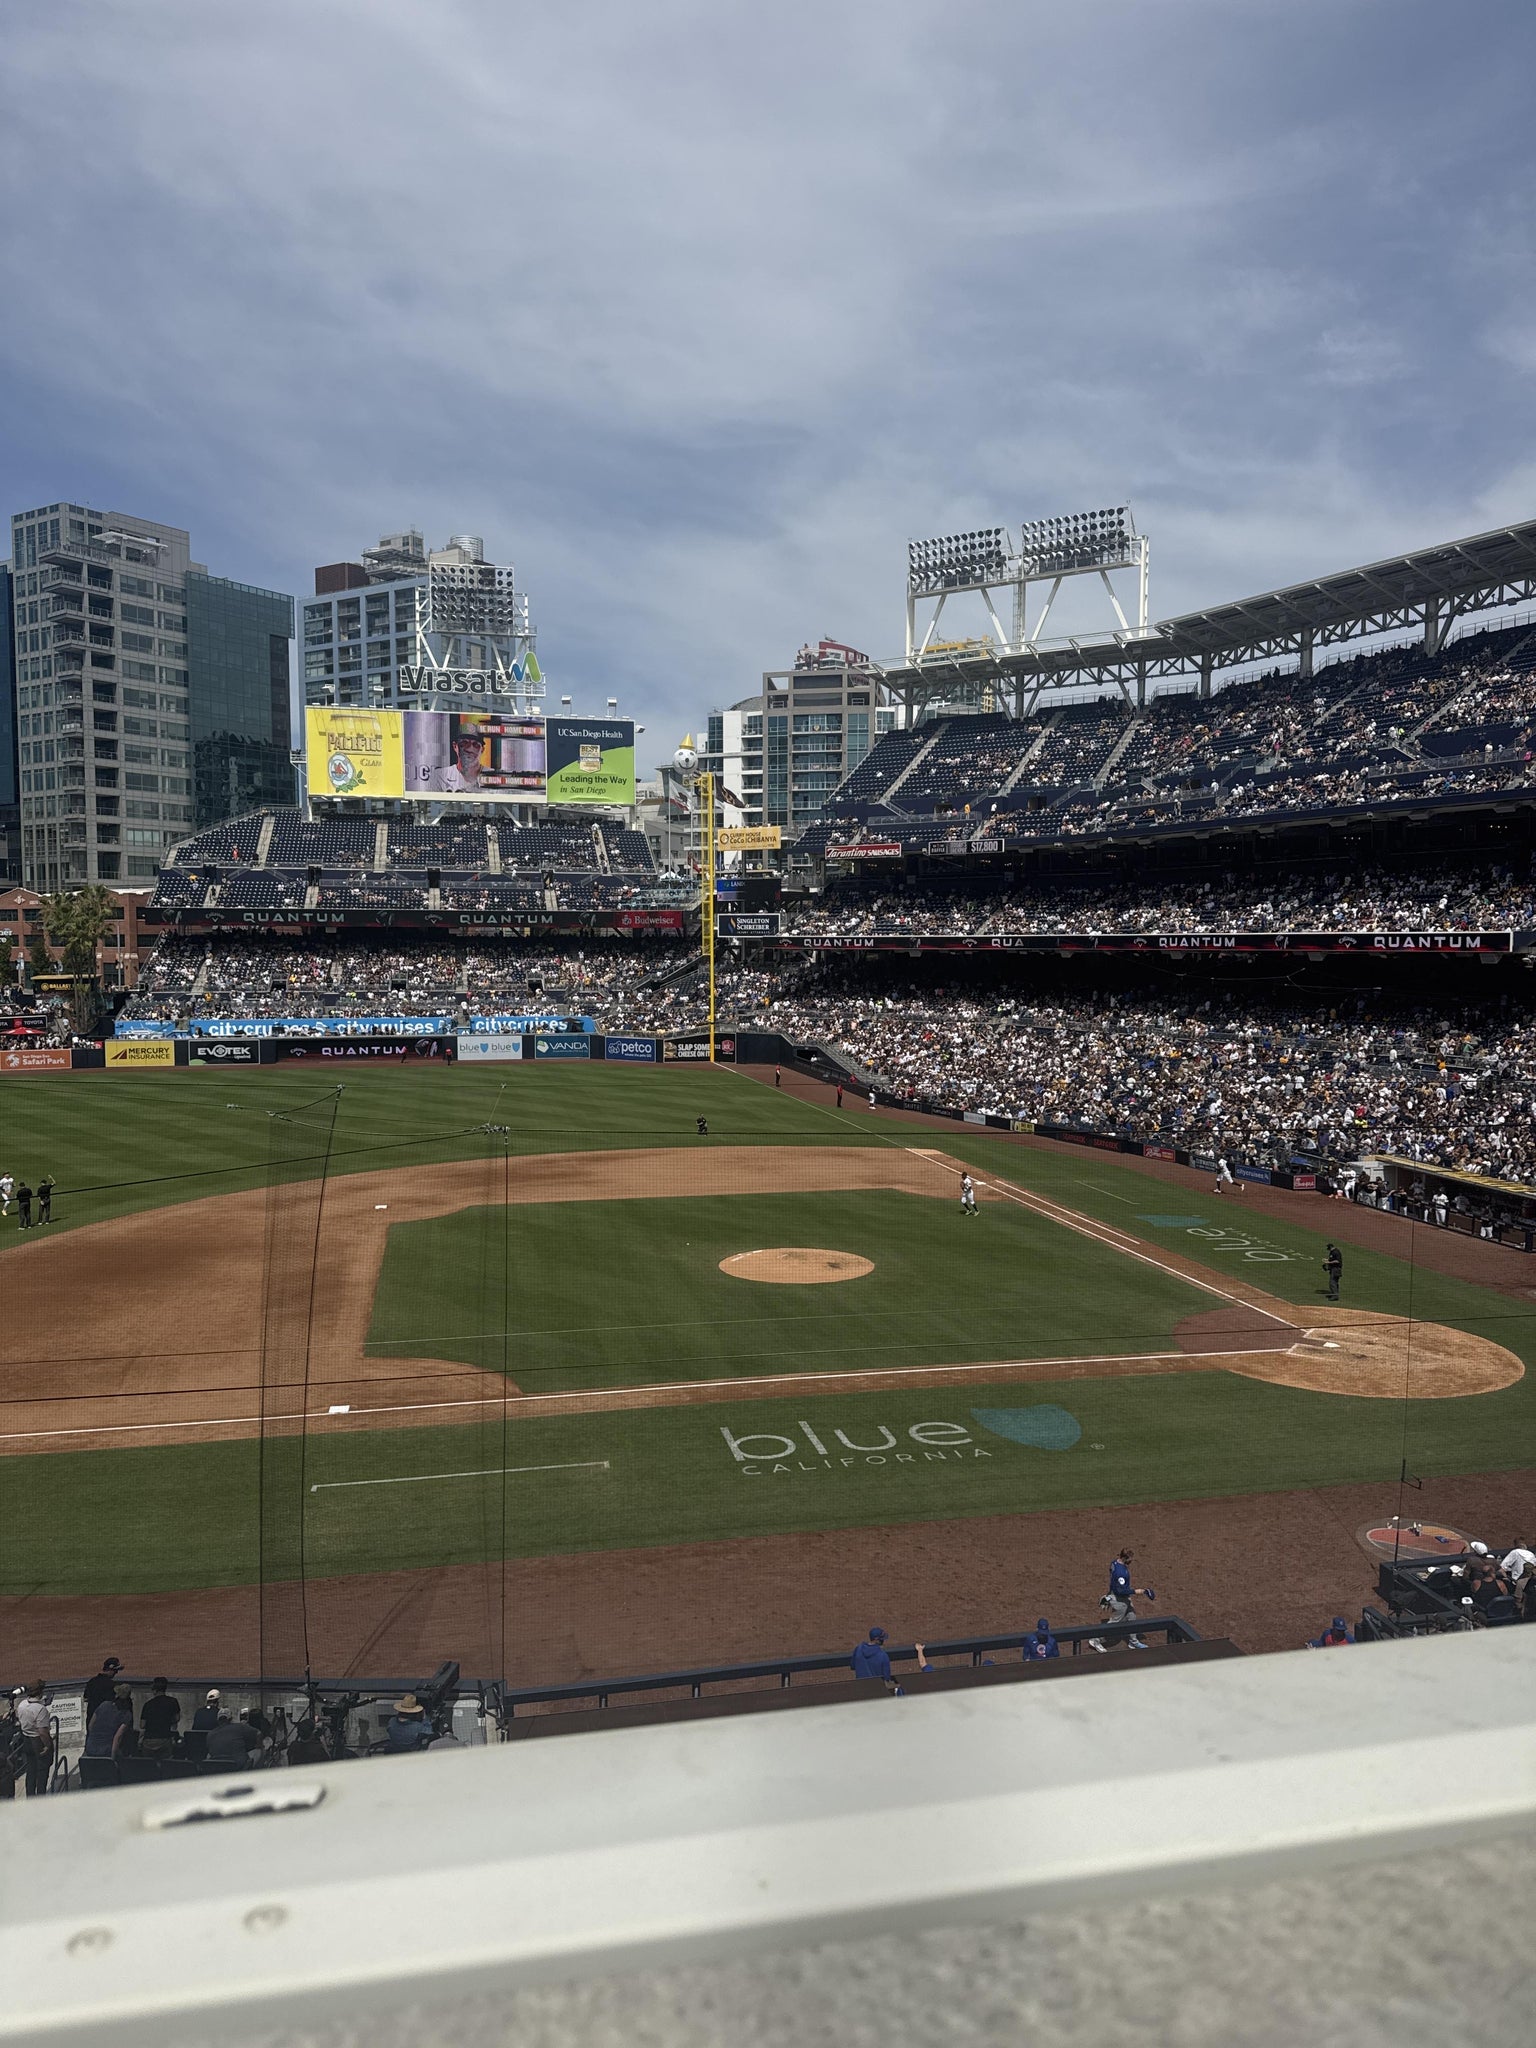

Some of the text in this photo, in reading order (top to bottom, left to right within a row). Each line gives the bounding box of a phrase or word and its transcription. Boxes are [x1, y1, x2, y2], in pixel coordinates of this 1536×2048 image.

[404, 665, 502, 694] Viasat
[558, 728, 623, 739] UC San Diego Health
[560, 774, 627, 786] Leading the Way
[560, 785, 606, 795] in San Diego
[971, 841, 998, 852] $17,800
[826, 847, 866, 858] Tarantino
[243, 913, 345, 923] QUANTUM
[460, 914, 553, 925] QUANTUM
[634, 915, 675, 925] Budweiser
[803, 938, 874, 948] QUANTUM
[1159, 937, 1235, 947] QUANTUM
[1374, 936, 1480, 949] QUANTUM
[198, 1044, 250, 1058] EVOTEK
[322, 1046, 406, 1056] QUANTUM
[460, 1043, 479, 1051] blue
[491, 1042, 511, 1051] blue
[550, 1042, 588, 1050] VANDA
[621, 1041, 652, 1055] petco
[694, 1043, 711, 1051] SOME
[678, 1050, 697, 1058] CHEESE
[47, 1057, 65, 1065] Park
[1236, 1168, 1264, 1179] citycruises
[719, 1421, 973, 1462] blue
[741, 1448, 992, 1475] CALIFORNIA
